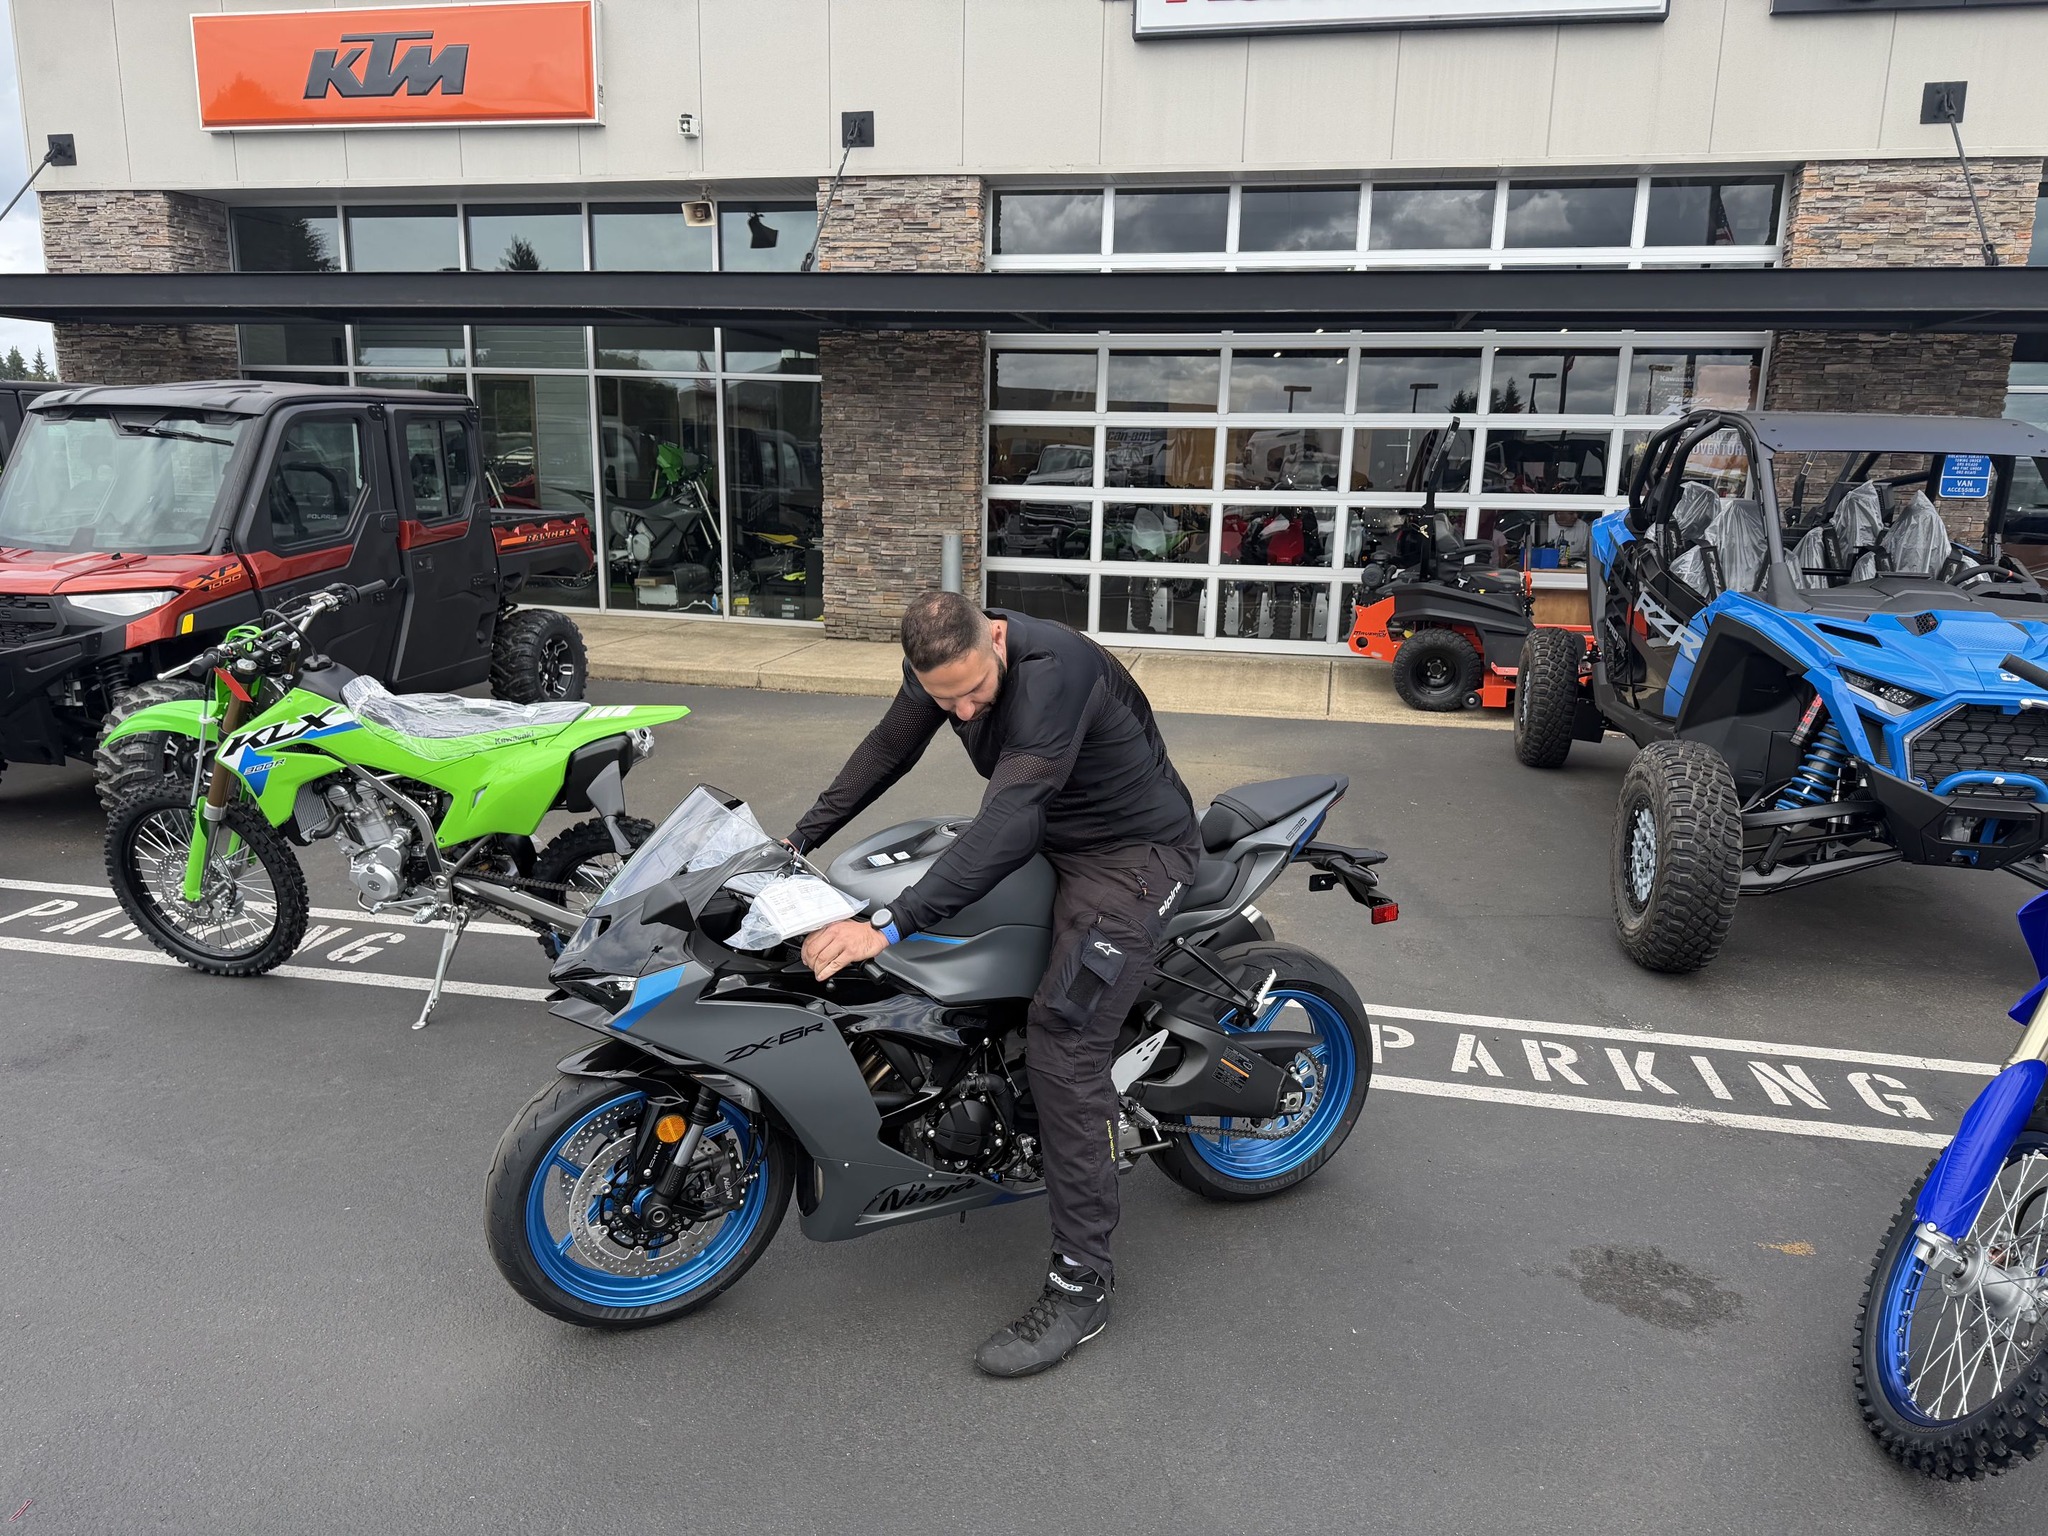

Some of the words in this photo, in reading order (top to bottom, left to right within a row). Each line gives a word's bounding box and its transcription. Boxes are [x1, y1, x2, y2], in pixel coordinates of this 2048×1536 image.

[303, 30, 470, 99] KTM
[196, 562, 239, 586] XP
[208, 573, 242, 591] 1000
[1634, 591, 1703, 664] RZR
[222, 707, 339, 758] KLX
[494, 729, 535, 745] Kawasaki
[245, 759, 286, 774] 300R
[723, 1023, 825, 1064] ZX-6R
[1371, 1023, 1933, 1121] PARKING
[879, 1177, 981, 1212] Ninja
